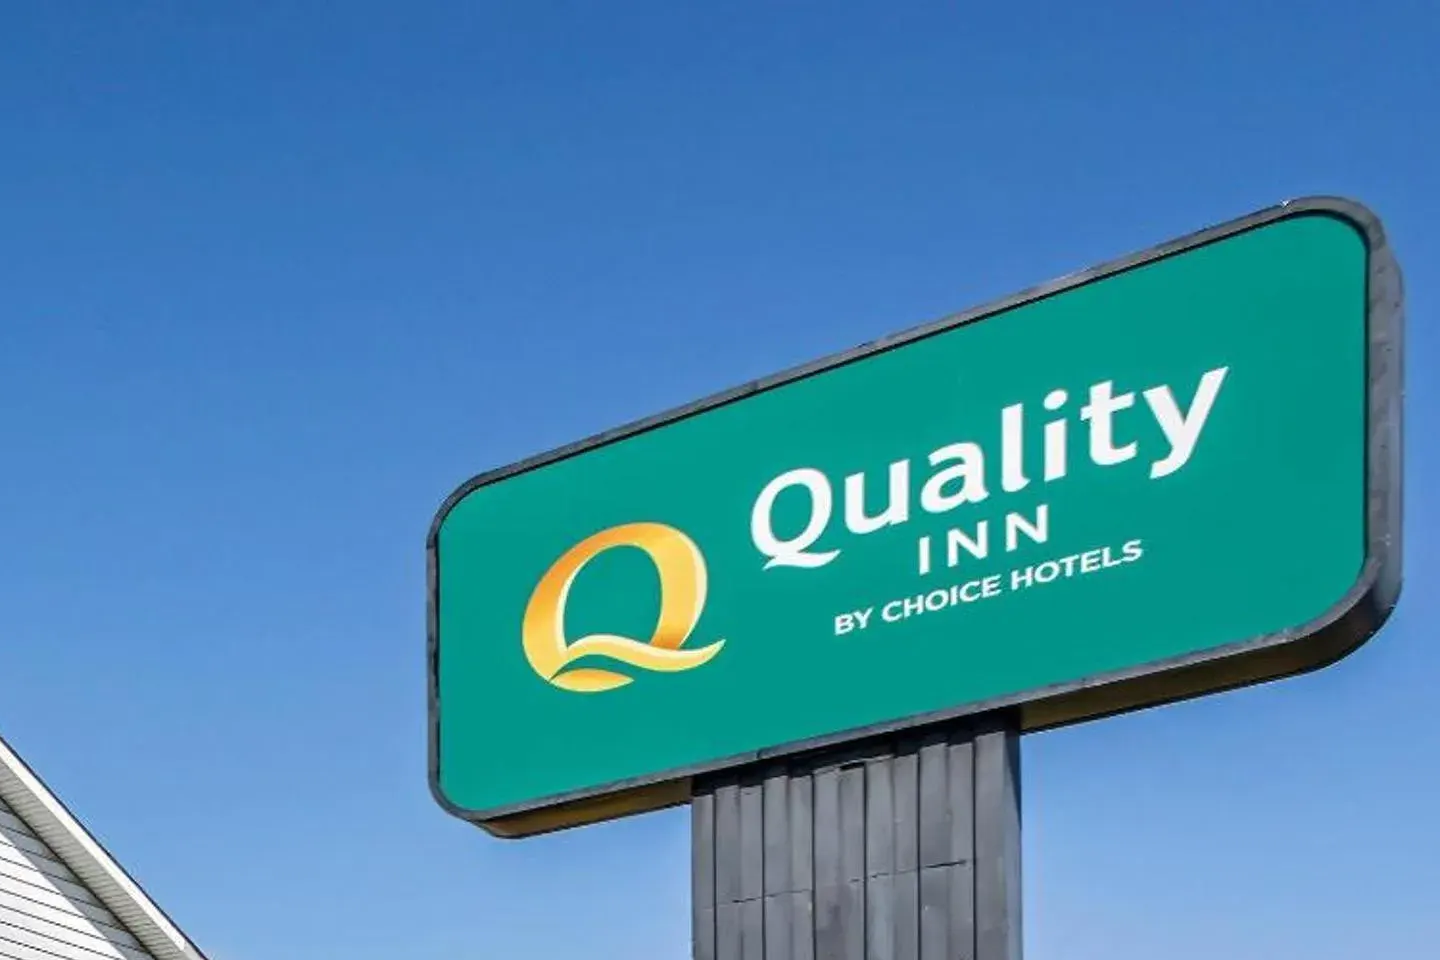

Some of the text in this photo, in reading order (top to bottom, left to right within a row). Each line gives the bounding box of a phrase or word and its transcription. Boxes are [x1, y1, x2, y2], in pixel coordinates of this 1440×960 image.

[750, 366, 1228, 569] Quality
[834, 539, 1144, 635] BY CHOICE HOTELS
[919, 504, 1049, 575] INN
